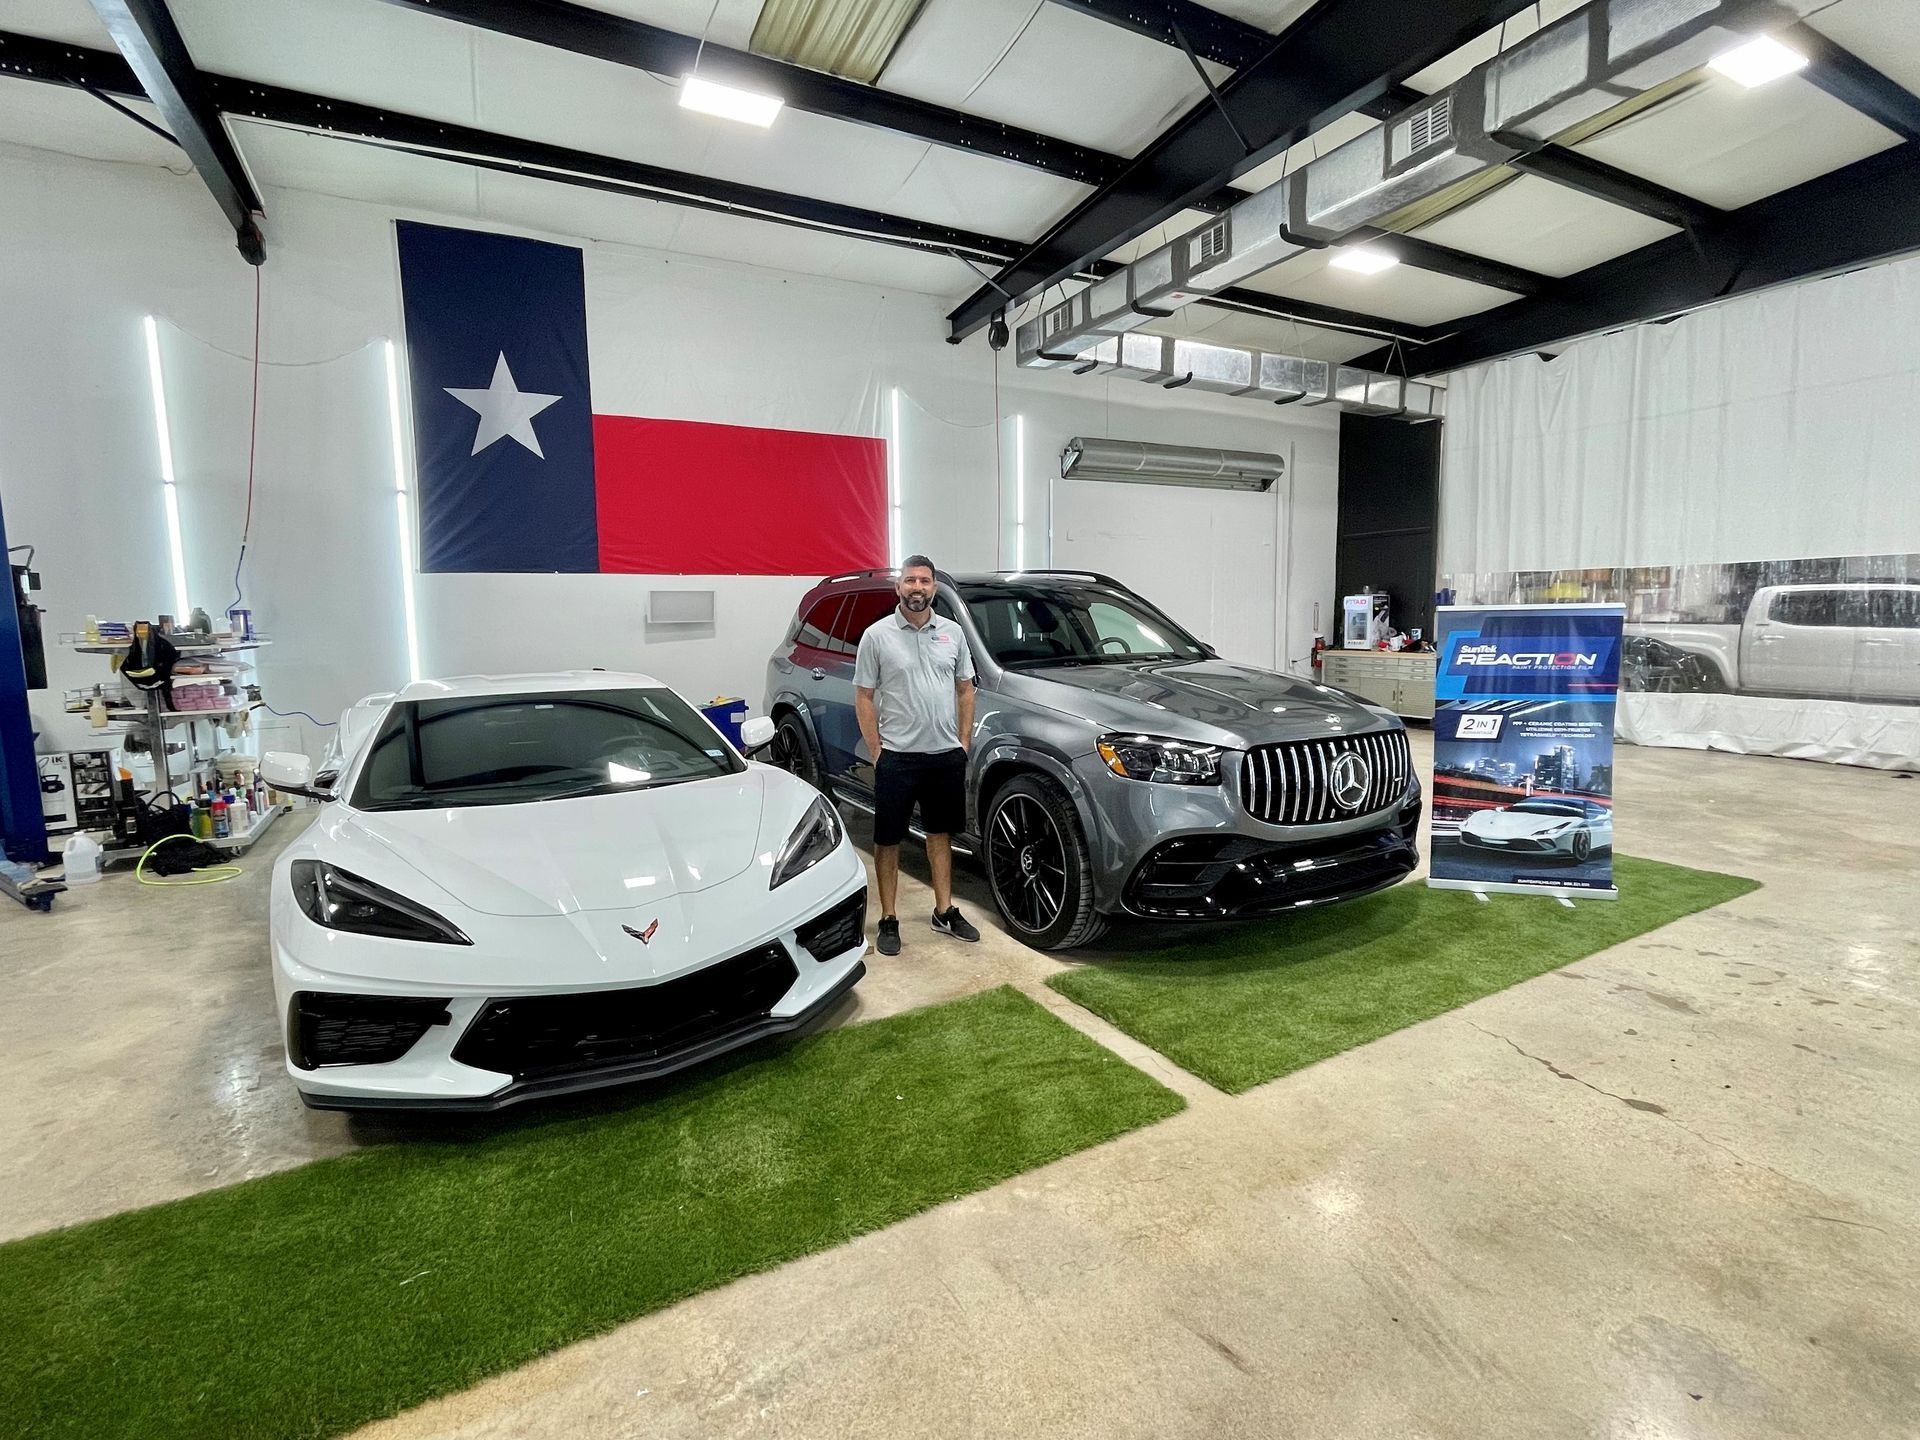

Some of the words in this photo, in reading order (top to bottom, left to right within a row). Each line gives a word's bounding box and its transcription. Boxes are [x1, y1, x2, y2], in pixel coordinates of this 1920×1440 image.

[1460, 645, 1498, 653] SunTek
[1456, 653, 1597, 666] REACTION
[1463, 718, 1476, 730] 2
[1492, 718, 1498, 730] 1
